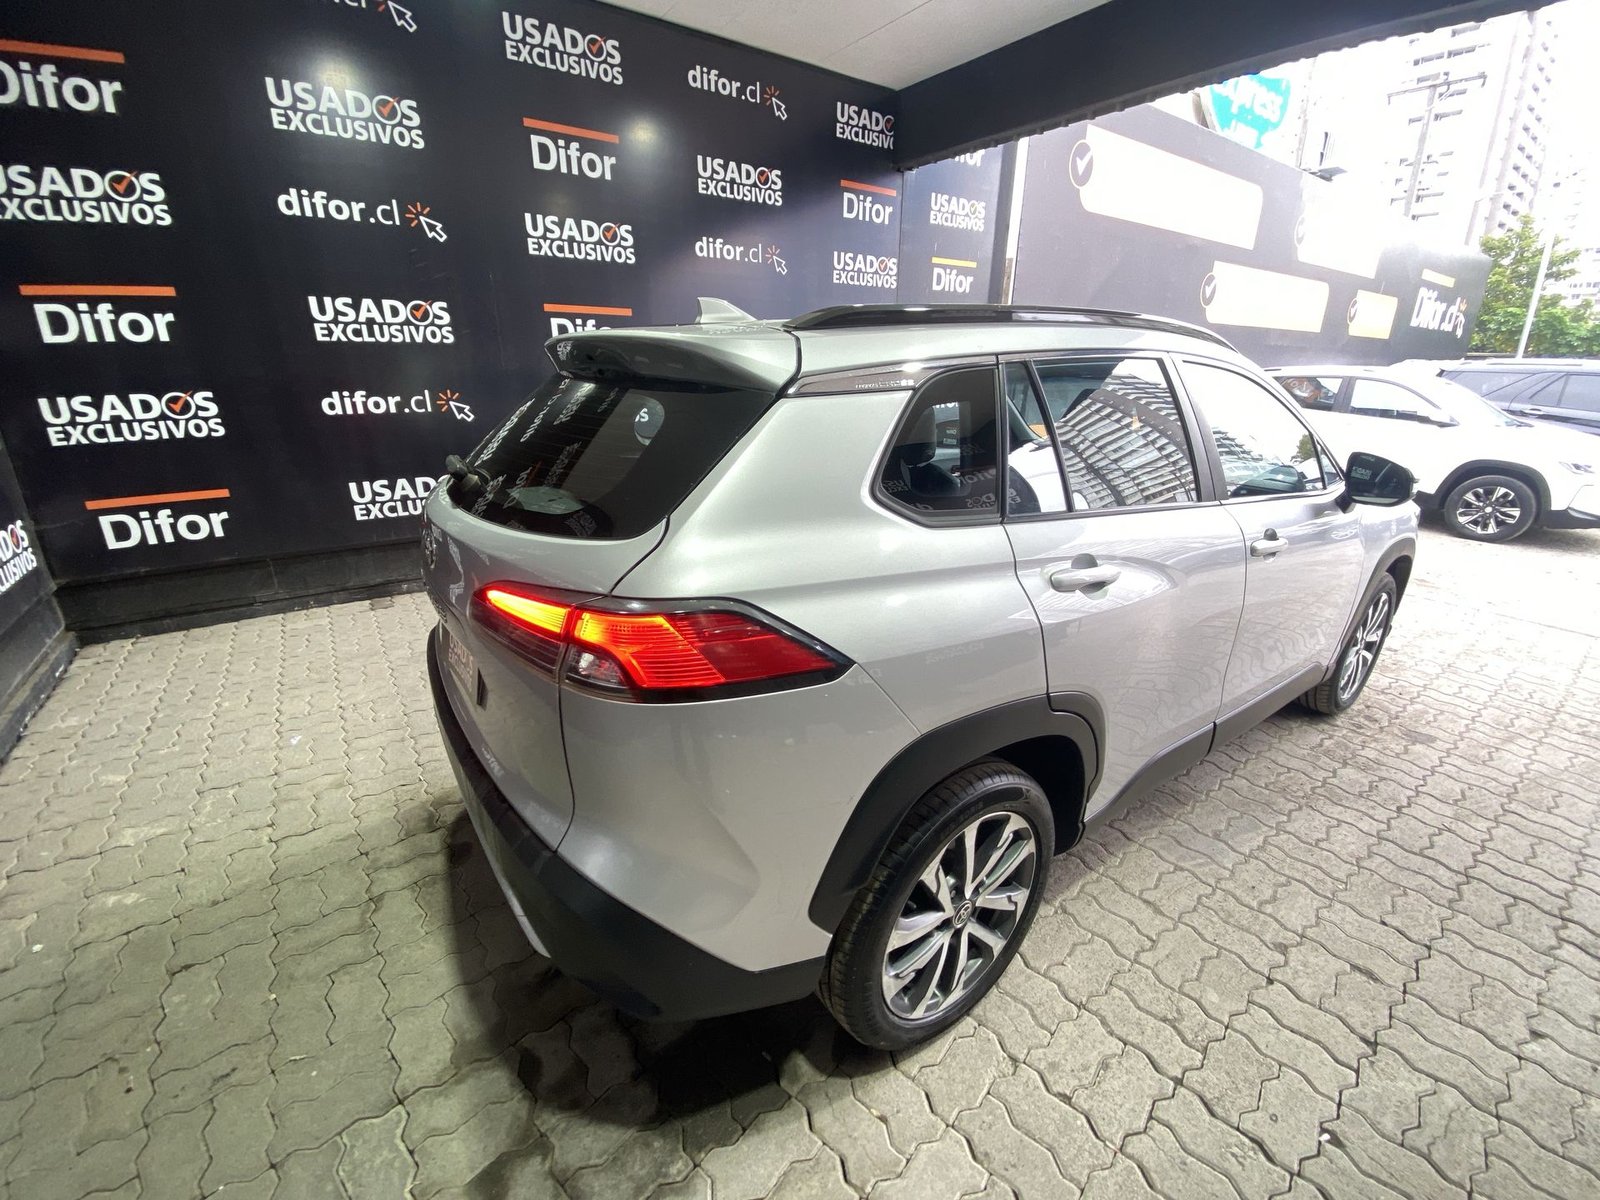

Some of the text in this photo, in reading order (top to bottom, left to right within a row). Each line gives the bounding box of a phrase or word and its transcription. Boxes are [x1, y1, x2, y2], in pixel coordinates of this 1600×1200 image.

[502, 11, 621, 64] USADOS
[505, 40, 623, 85] EXCLUSIVOS
[688, 65, 760, 104] difor.cl
[265, 77, 420, 127] USADOS
[270, 108, 425, 149] EXCLUSIVOS
[836, 123, 893, 150] EXCLUSIV
[530, 135, 616, 181] Difor
[697, 155, 782, 189] USADOS
[0, 165, 165, 202] SADOS
[698, 178, 782, 206] EXCLUSIVOS
[0, 197, 172, 226] XCLUSIVOS
[278, 188, 400, 226] difor.cl
[843, 192, 893, 224] Difor
[931, 192, 986, 218] USADOS
[525, 213, 633, 246] USADOS
[930, 210, 984, 232] EXCLUSIVOS
[527, 238, 635, 264] EXCLUSIVOS
[695, 237, 762, 263] difor.cl
[834, 251, 897, 276] USADOS
[833, 269, 897, 289] EXCLUSIVOS
[932, 268, 973, 293] Difor
[34, 303, 175, 343] Difor
[308, 296, 451, 324] USADOS
[314, 323, 454, 343] EXCLUSIVOS
[38, 391, 219, 424] USADOS
[321, 390, 432, 415] difor.cl
[47, 418, 225, 446] EXCLUSIVOS
[349, 475, 449, 503] USAD
[354, 499, 427, 520] EXCLU
[98, 509, 229, 549] Difor
